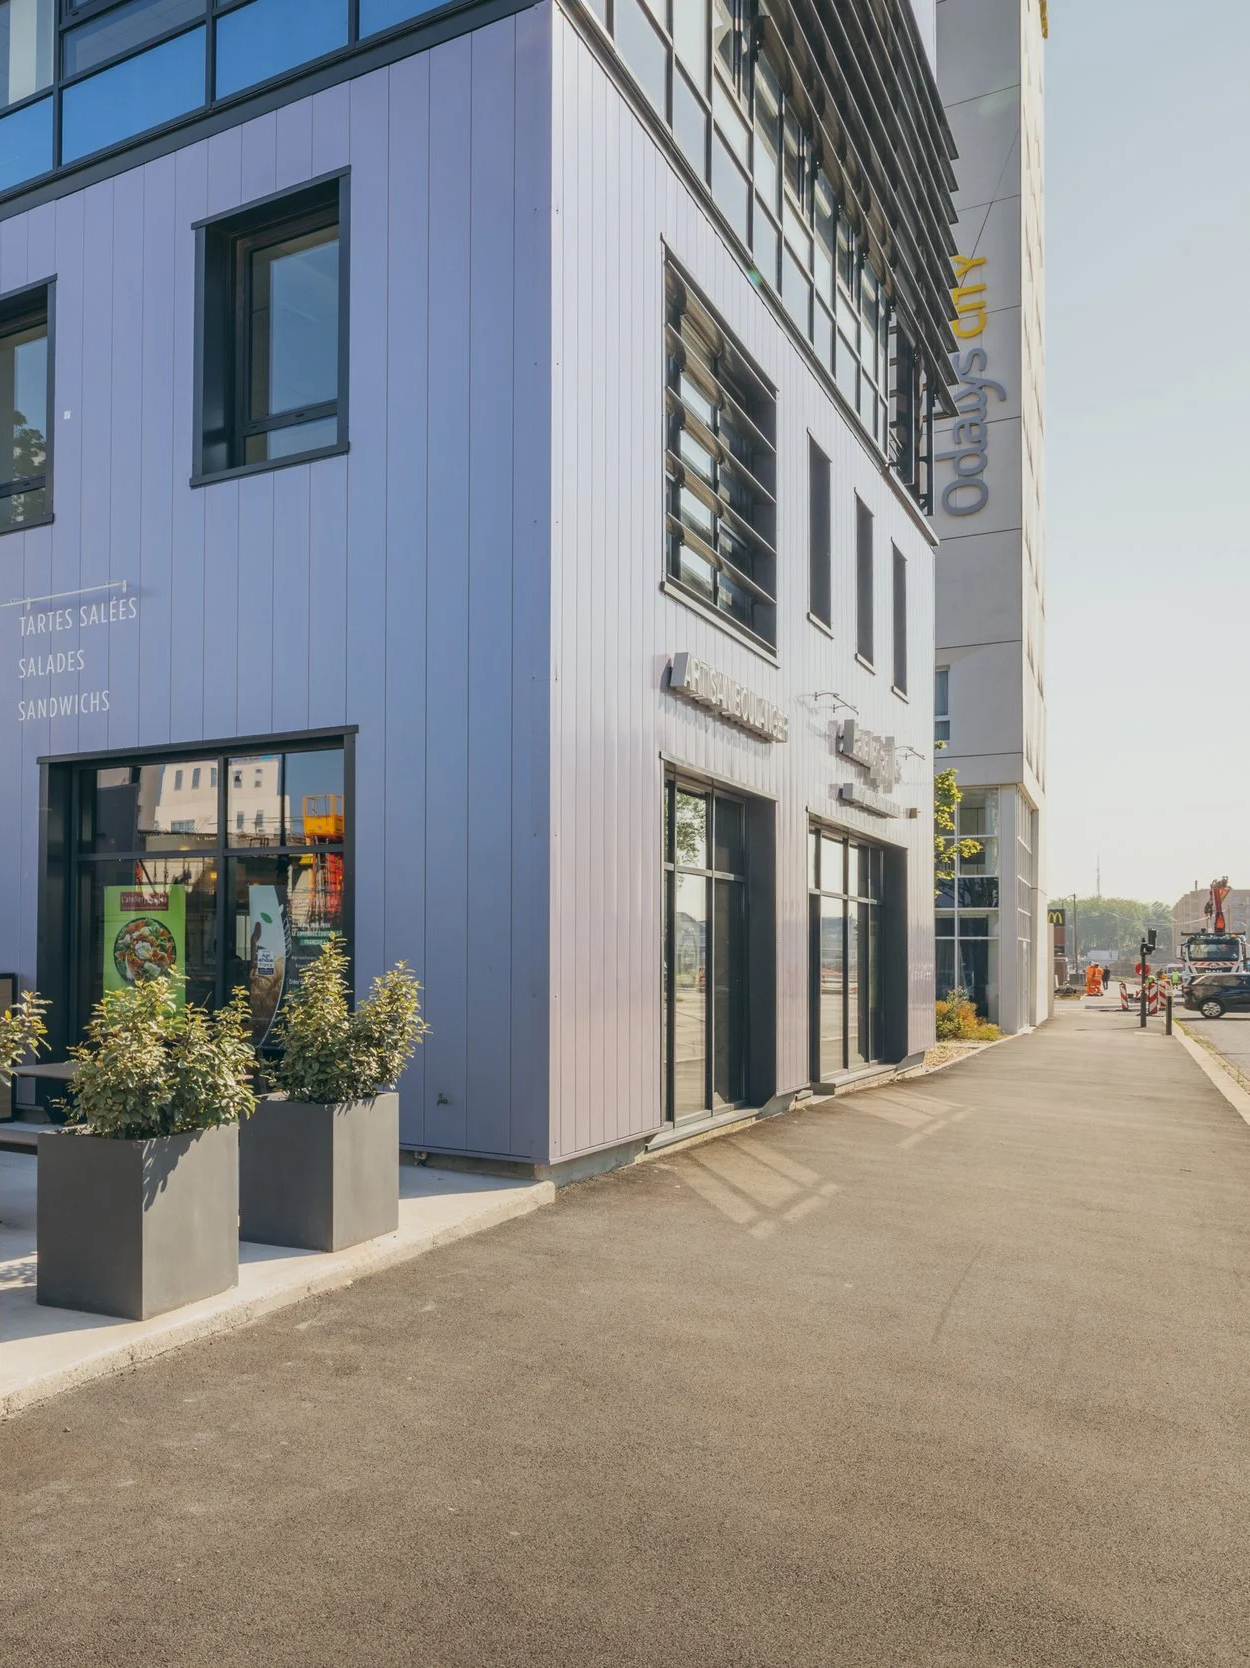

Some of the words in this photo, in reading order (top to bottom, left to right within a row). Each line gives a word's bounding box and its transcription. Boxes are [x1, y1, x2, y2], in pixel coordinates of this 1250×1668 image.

[953, 255, 987, 339] CITY
[19, 608, 73, 636] TARTES
[79, 596, 137, 627] SALÉES
[18, 649, 85, 679] SALADES
[18, 690, 110, 721] SANDWICHS
